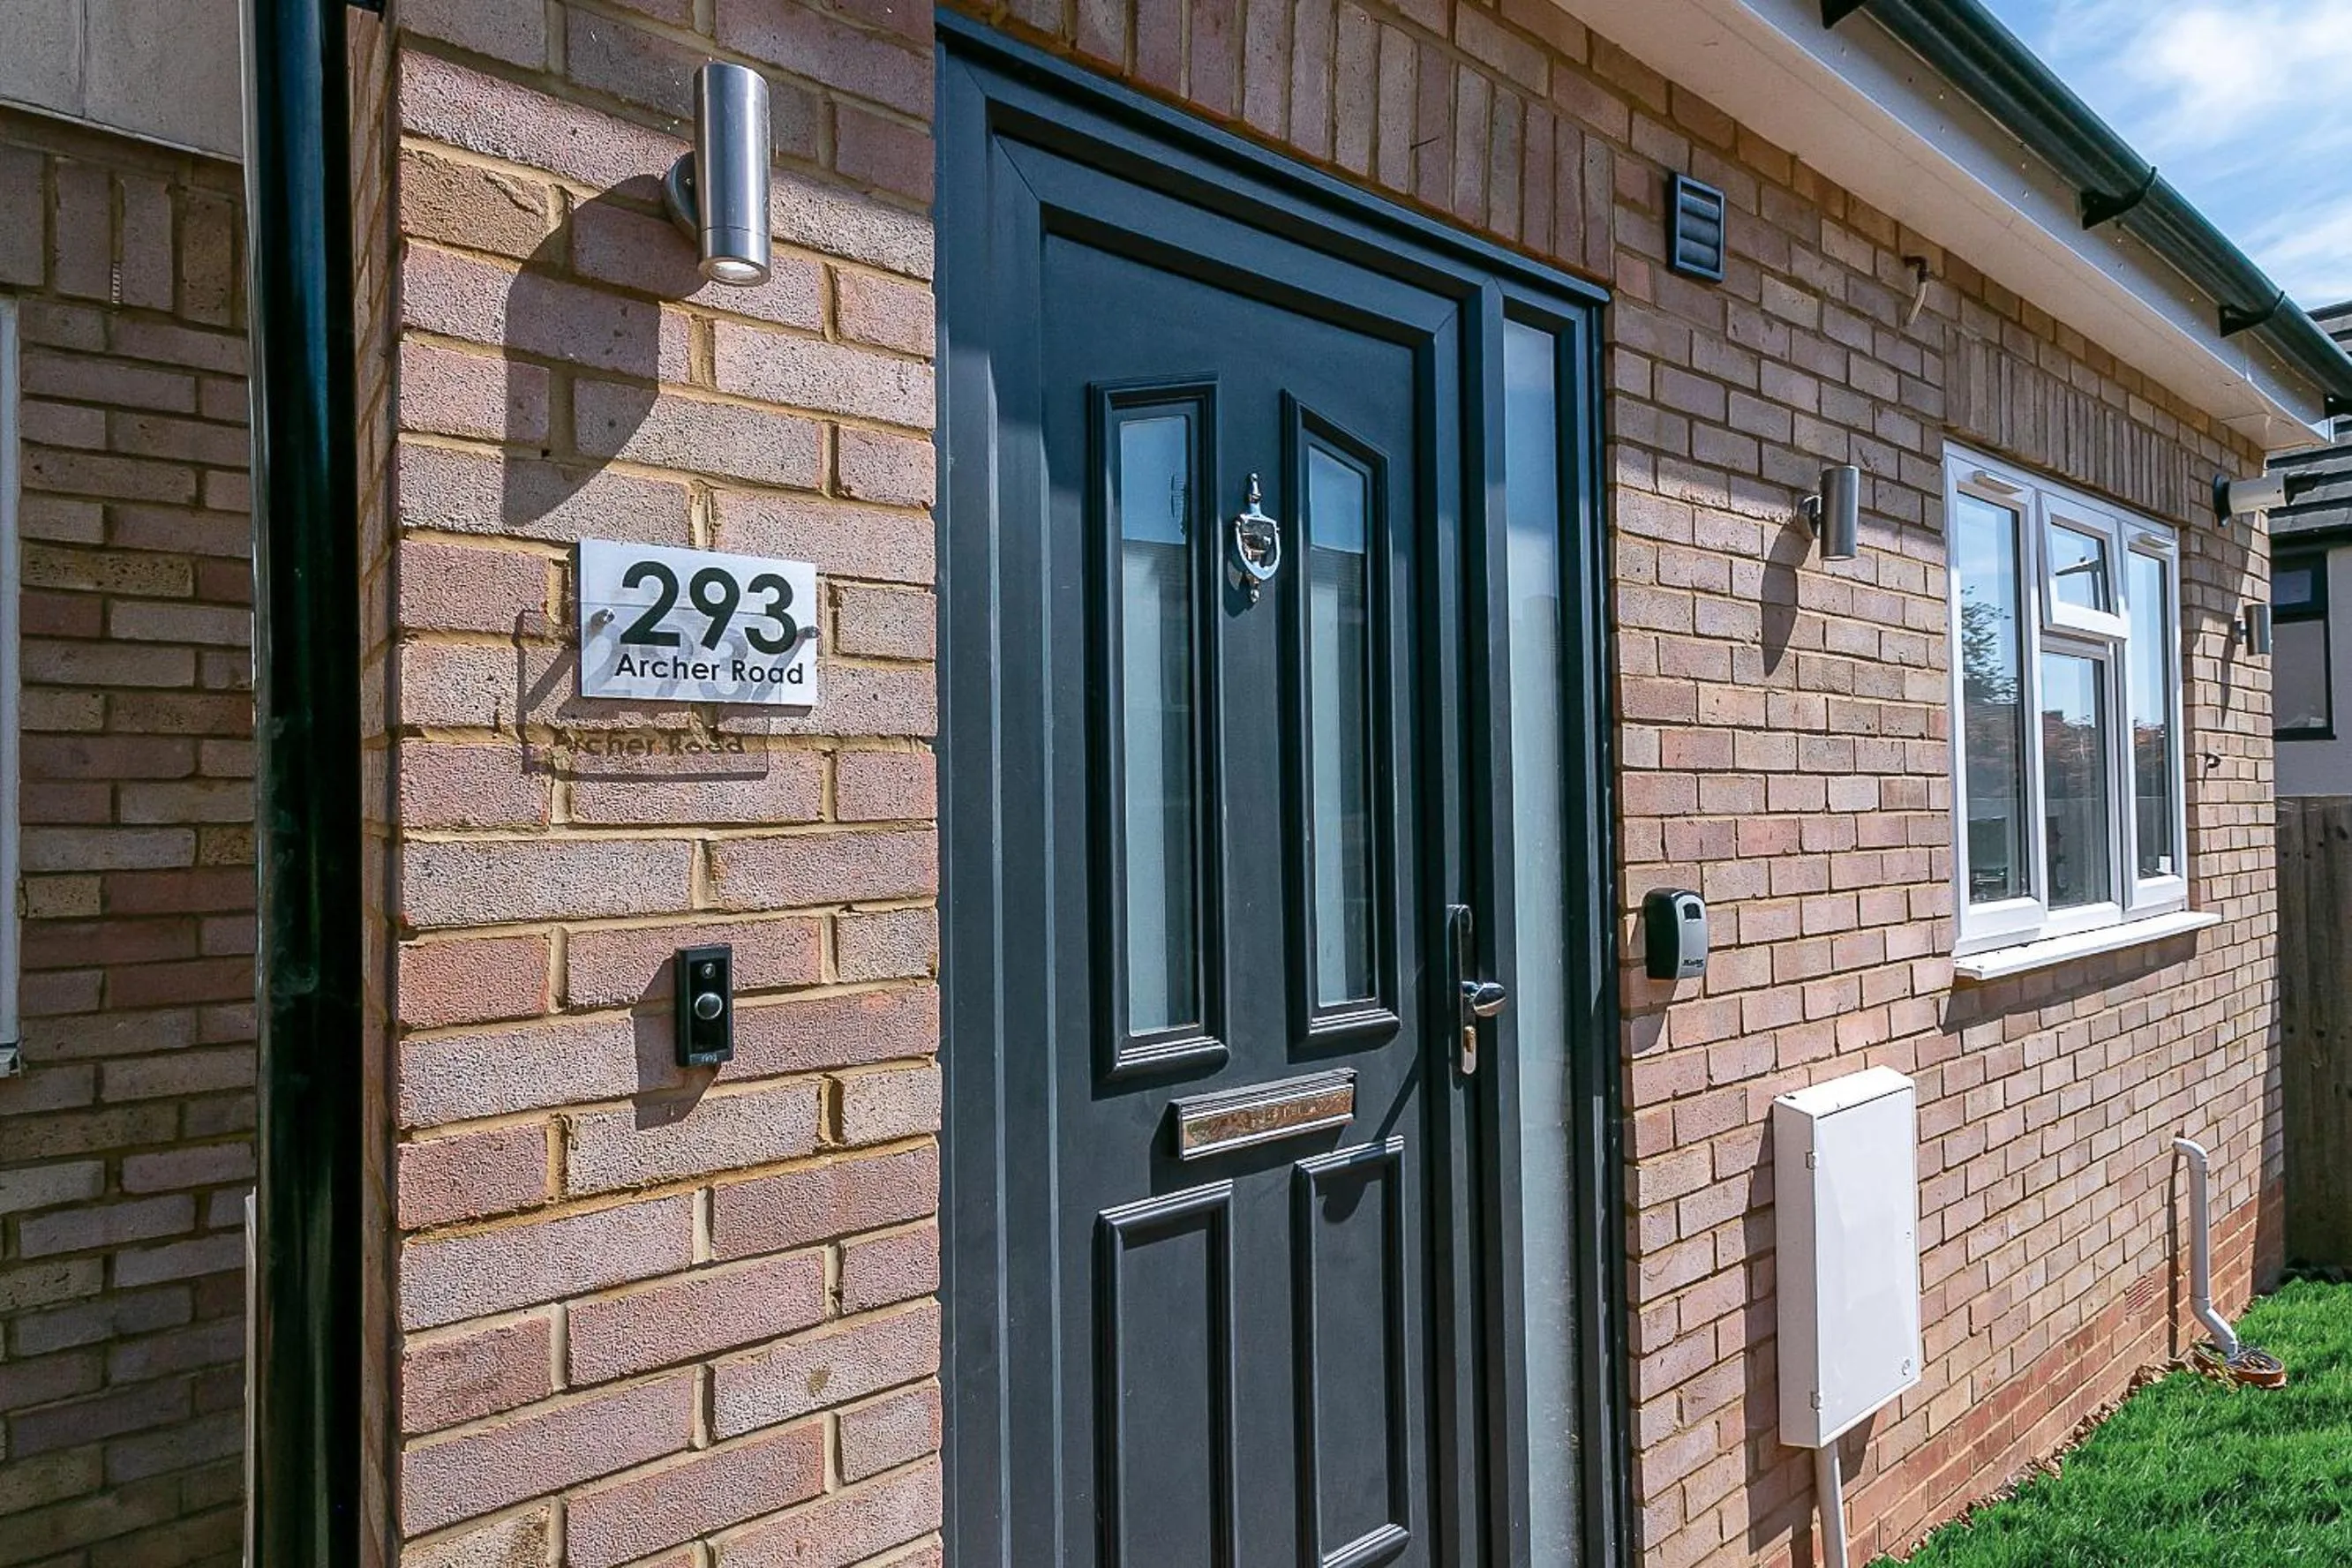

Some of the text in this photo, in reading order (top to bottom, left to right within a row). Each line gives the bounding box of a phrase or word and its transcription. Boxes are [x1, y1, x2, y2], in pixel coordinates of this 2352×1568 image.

[620, 560, 797, 655] 293
[614, 653, 803, 685] Archer Road
